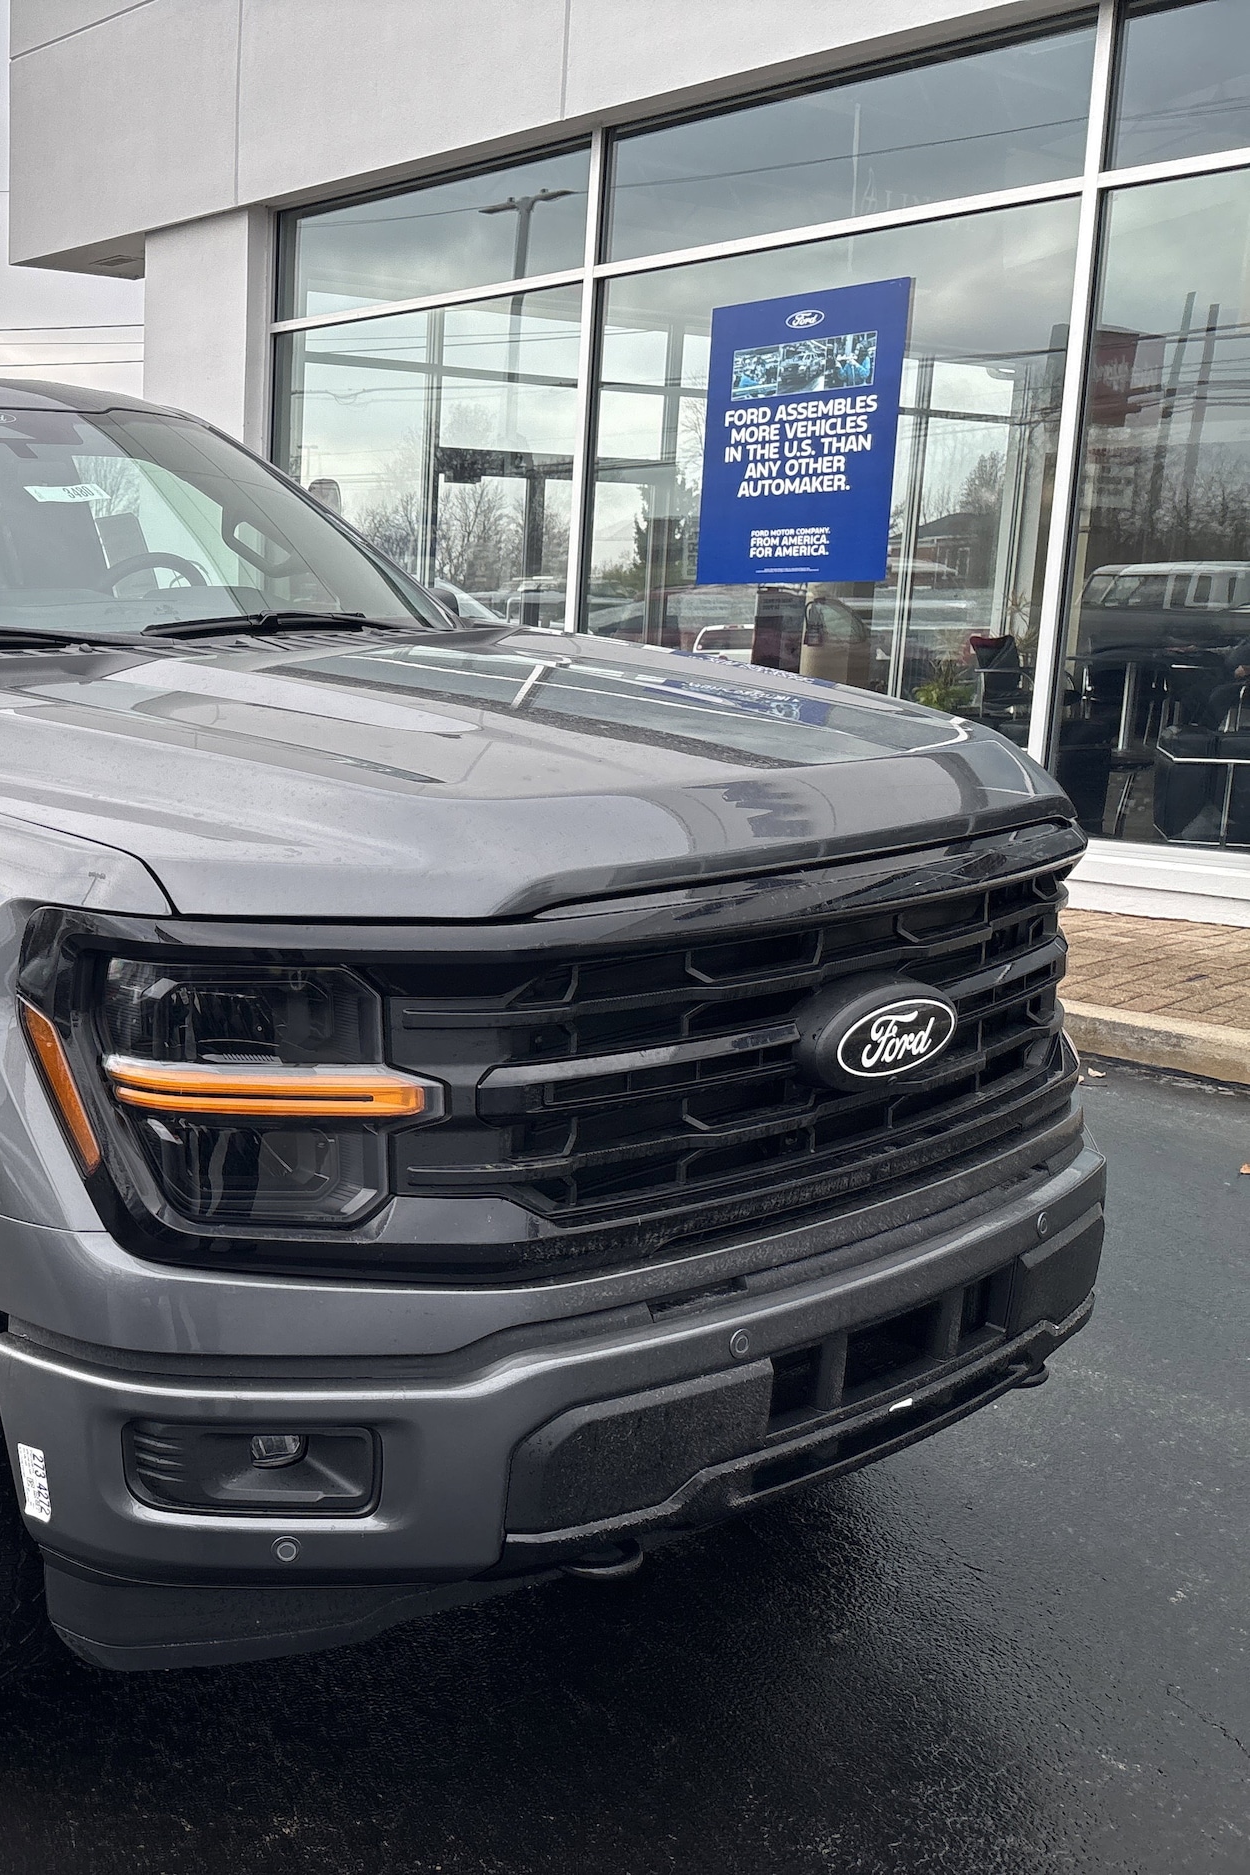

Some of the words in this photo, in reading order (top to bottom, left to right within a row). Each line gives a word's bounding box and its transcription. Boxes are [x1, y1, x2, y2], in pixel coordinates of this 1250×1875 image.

[792, 312, 818, 326] Ford
[724, 407, 771, 427] FORD
[774, 394, 878, 422] ASSEMBLES
[730, 424, 781, 444] MORE
[784, 415, 868, 440] VEHICLES
[724, 445, 742, 463] IN
[746, 442, 780, 461] THE
[784, 439, 816, 458] U.S.
[820, 434, 872, 454] THAN
[744, 460, 781, 479] ANY
[784, 455, 846, 476] OTHER
[62, 485, 95, 499] 3480
[736, 474, 850, 498] AUTOMAKER.
[750, 529, 770, 537] FORD
[770, 528, 795, 537] MOTOR
[795, 526, 831, 535] COMPANY.
[750, 537, 780, 547] FROM
[781, 534, 830, 546] AMERICA.
[749, 546, 773, 558] FOR
[774, 545, 829, 557] AMERICA.
[861, 1010, 935, 1068] Ford
[32, 1453, 46, 1480] 273
[36, 1482, 51, 1516] 4272
